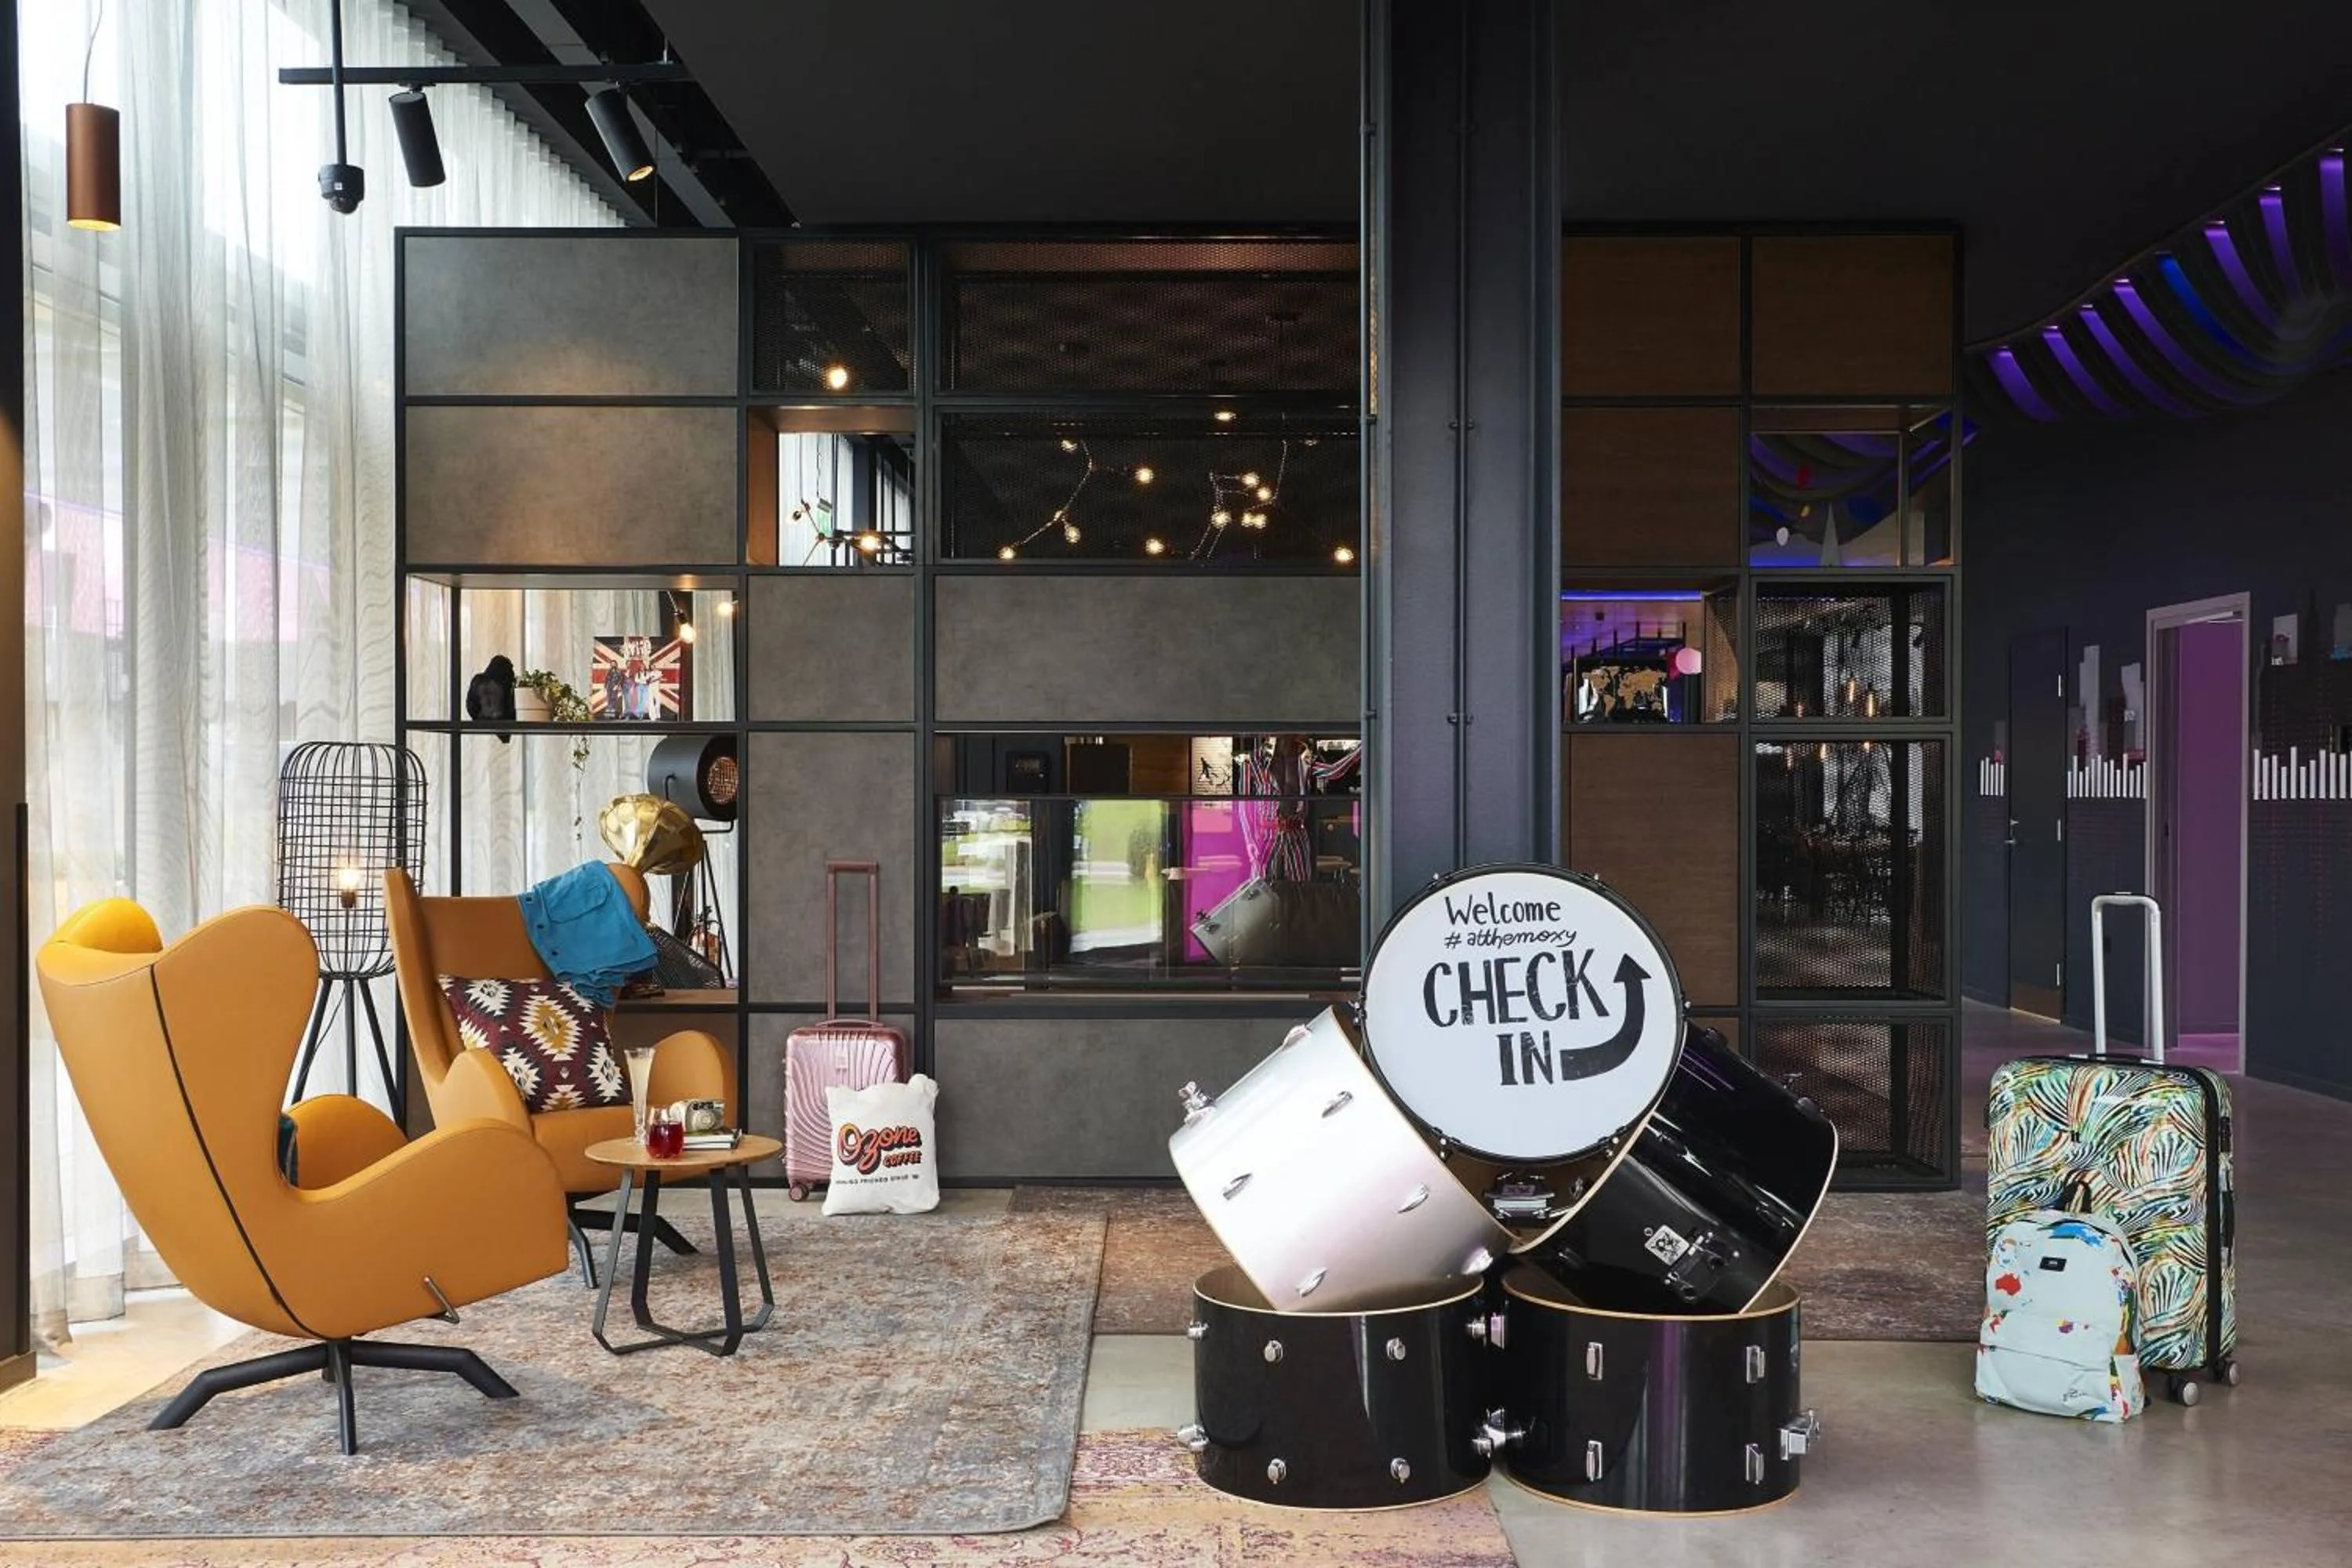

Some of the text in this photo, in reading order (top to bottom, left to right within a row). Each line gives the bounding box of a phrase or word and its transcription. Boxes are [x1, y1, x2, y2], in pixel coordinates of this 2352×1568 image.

[1444, 891, 1562, 926] Welcome
[1423, 949, 1610, 1028] CHECK
[1497, 1030, 1554, 1086] IN
[837, 1122, 922, 1174] Ozone
[884, 1151, 922, 1168] COFFEE
